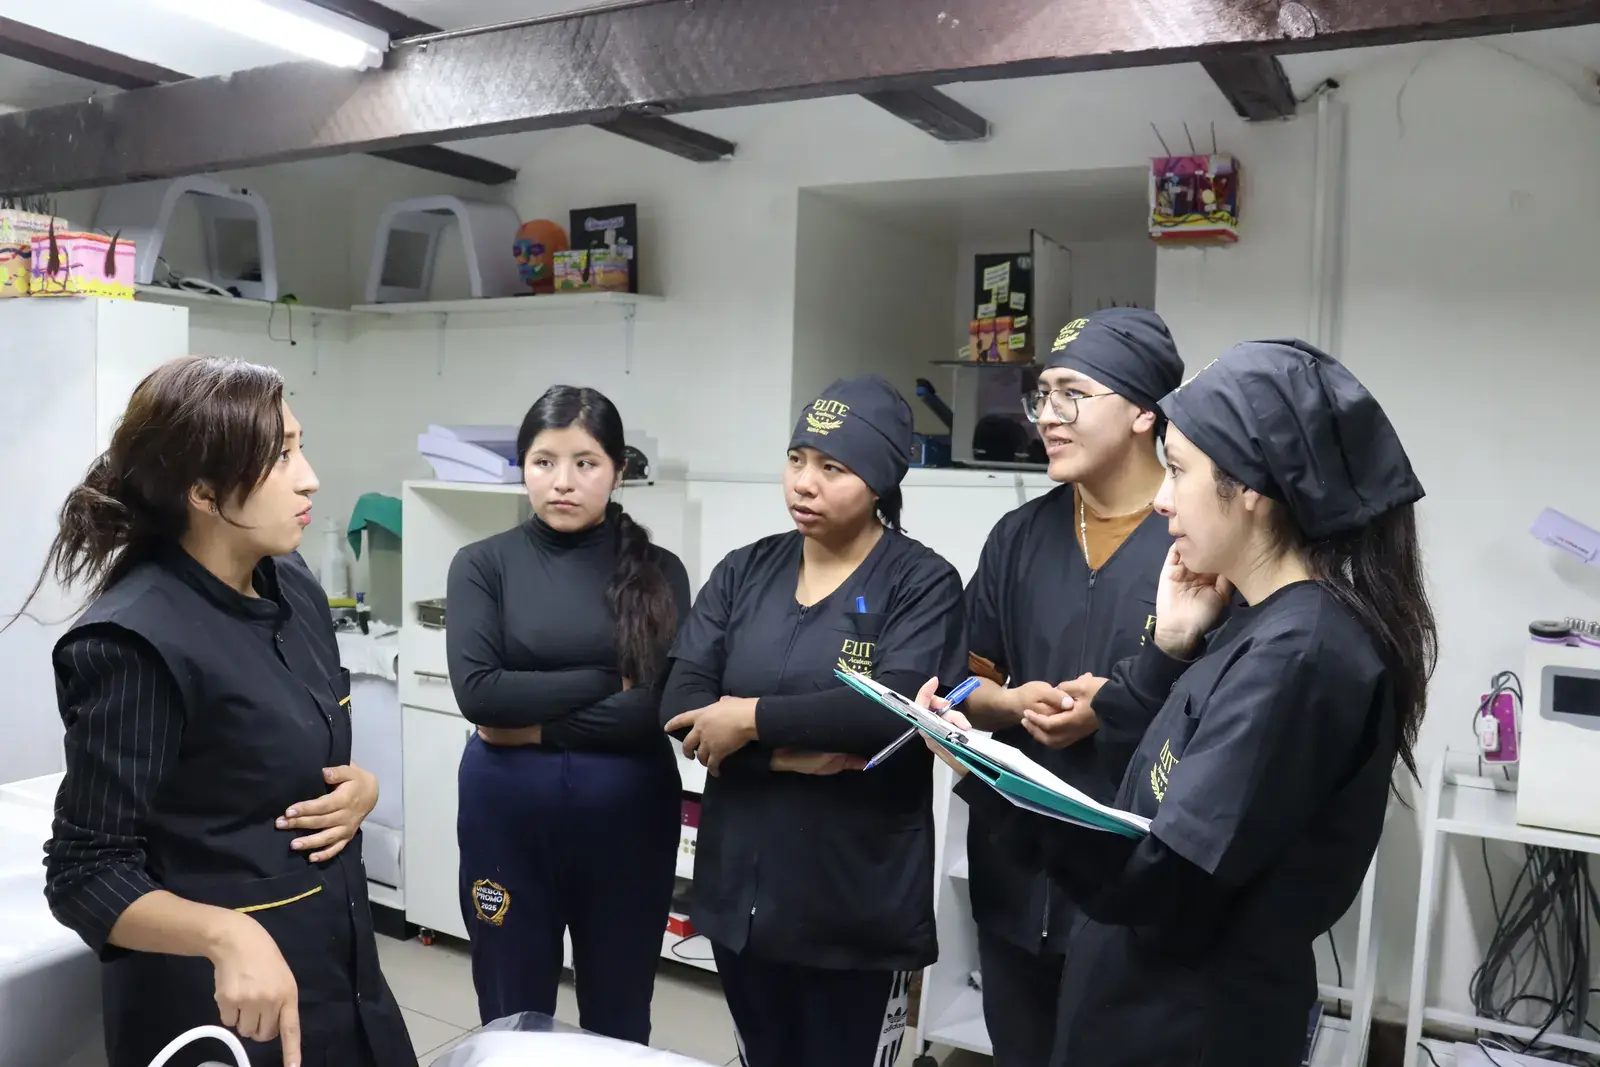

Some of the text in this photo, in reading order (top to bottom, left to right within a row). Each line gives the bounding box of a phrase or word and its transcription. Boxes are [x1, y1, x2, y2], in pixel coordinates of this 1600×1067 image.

[812, 399, 850, 417] ELITE
[840, 638, 876, 658] ELIT
[476, 891, 503, 903] PROMO
[481, 902, 497, 912] 2025
[883, 1022, 906, 1034] adidas
